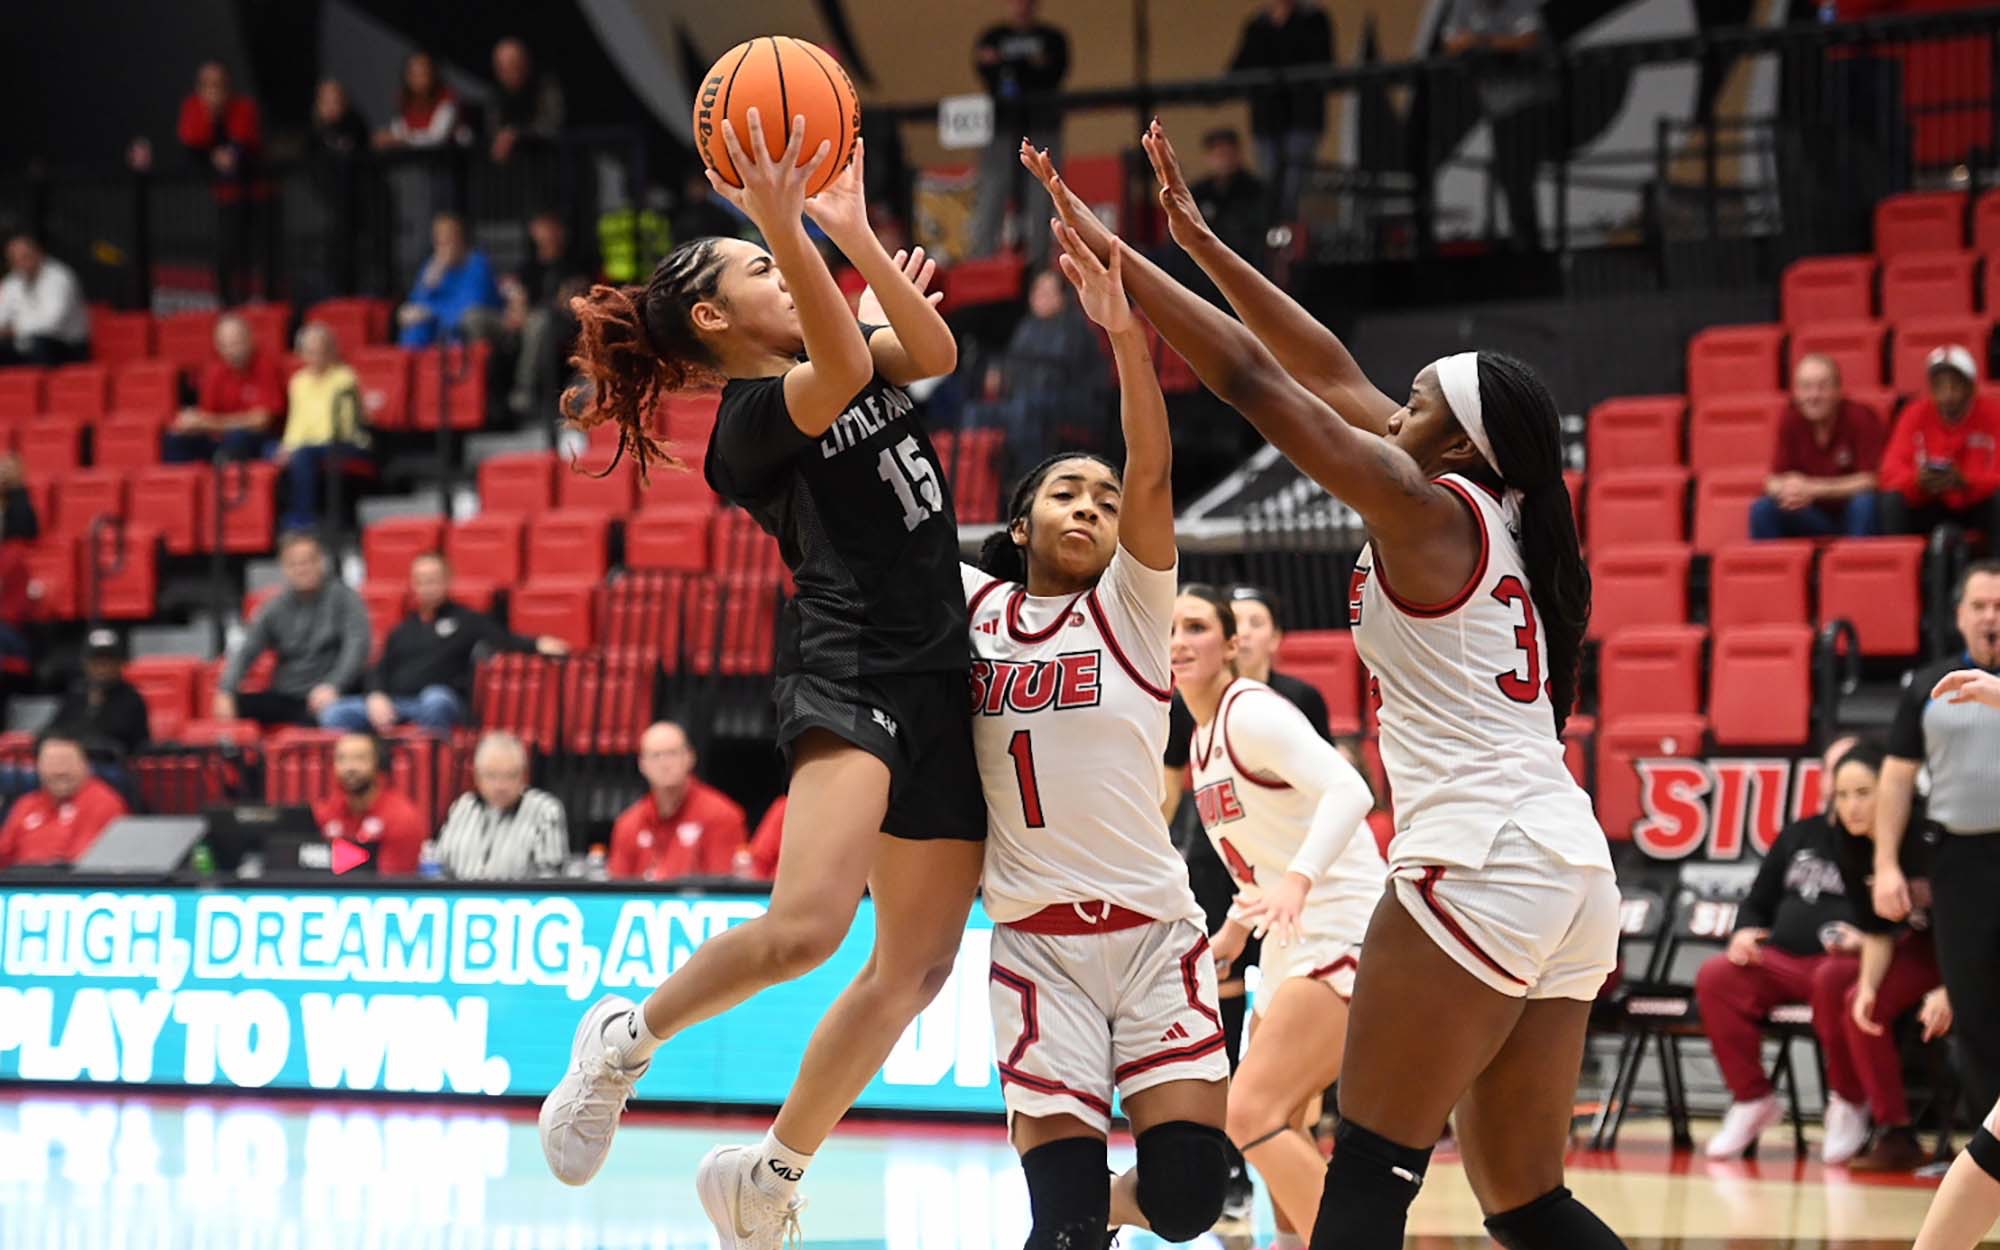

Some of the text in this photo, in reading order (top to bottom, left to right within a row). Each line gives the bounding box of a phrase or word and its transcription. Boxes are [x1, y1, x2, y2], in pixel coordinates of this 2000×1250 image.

[700, 76, 724, 170] Wilso
[877, 433, 943, 532] 15
[970, 649, 1102, 716] SIUE
[1490, 574, 1553, 704] 3
[1008, 729, 1046, 828] 1
[1632, 758, 1828, 860] SIU
[4, 893, 769, 1001] HIGH, DREAM BIG, AN
[173, 988, 291, 1088] TO
[301, 992, 511, 1096] WIN.
